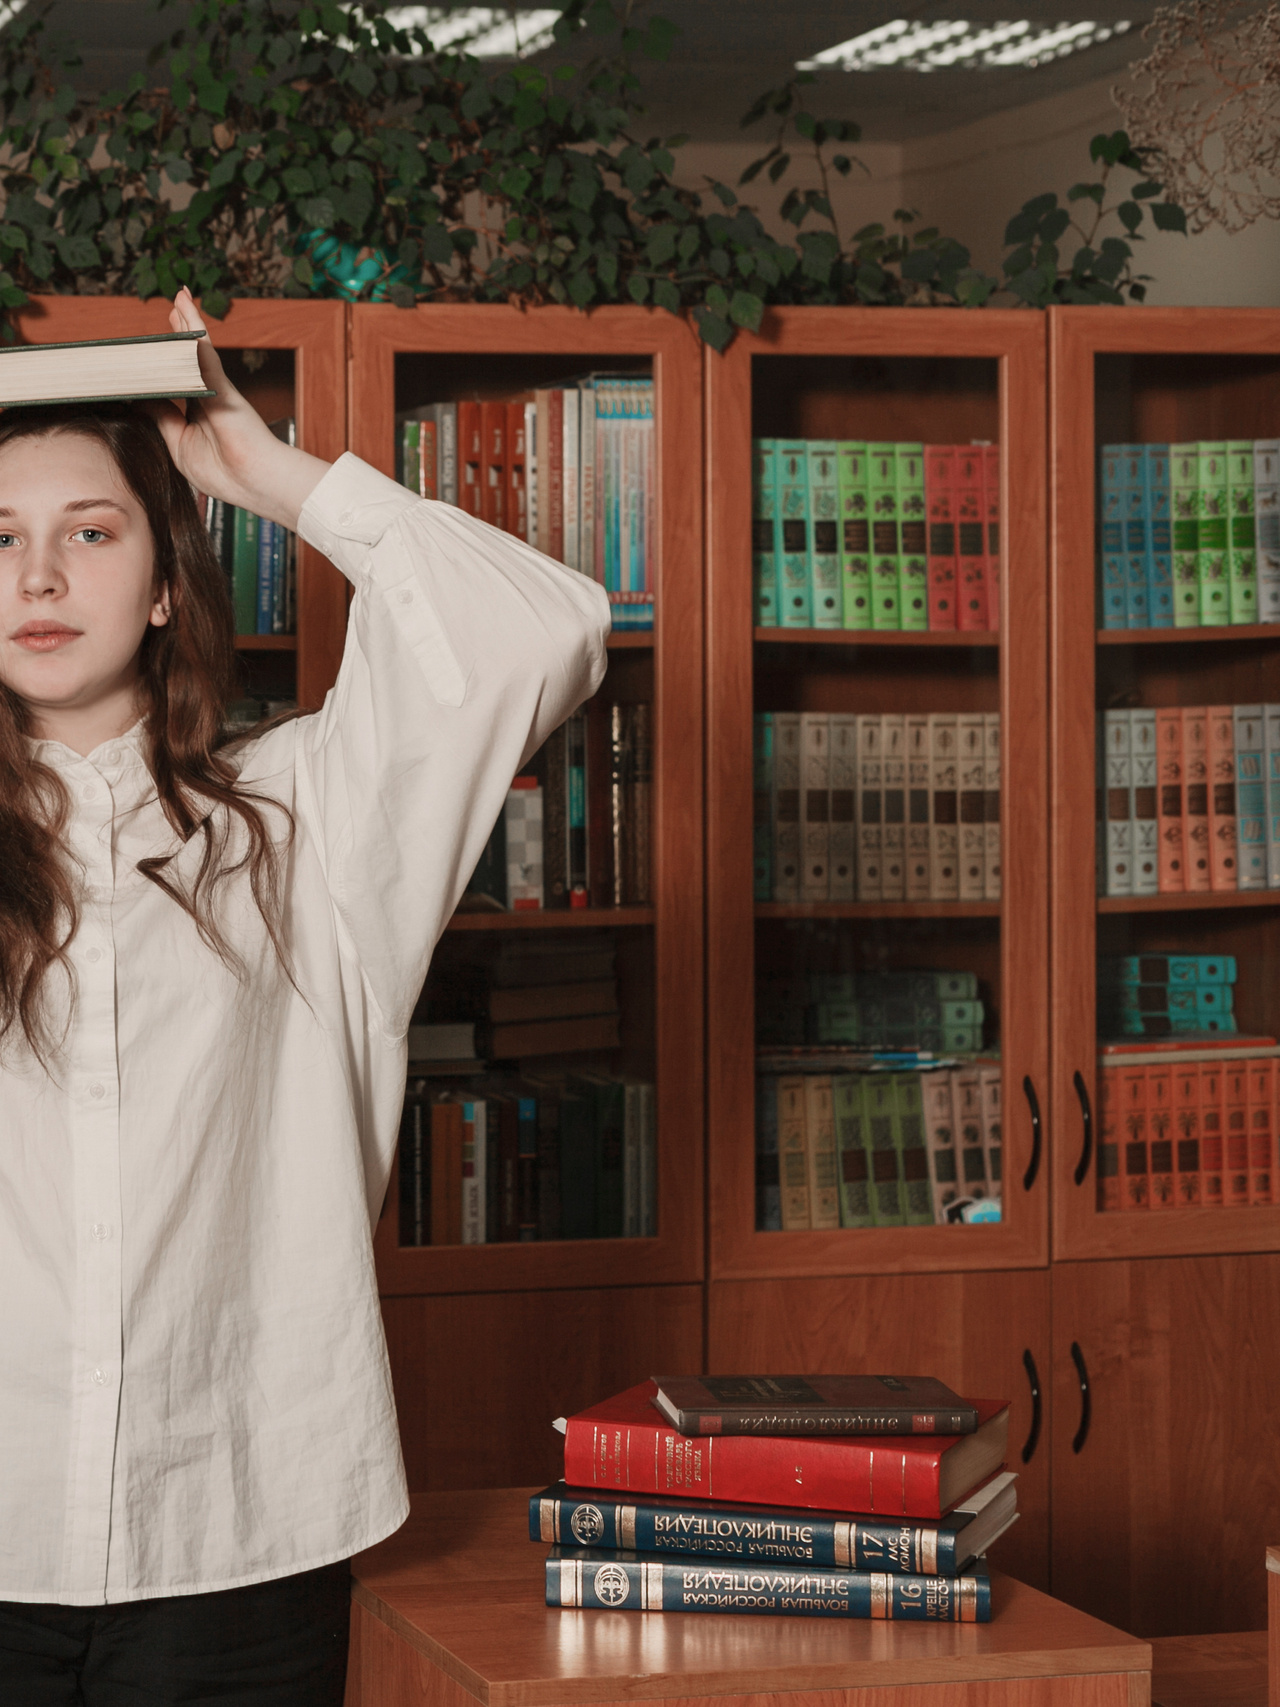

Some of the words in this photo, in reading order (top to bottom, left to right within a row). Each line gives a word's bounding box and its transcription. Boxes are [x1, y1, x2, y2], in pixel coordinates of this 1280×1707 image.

[739, 1415, 899, 1431] ЭНЦИКЛОПЕДИЯ
[665, 1435, 674, 1488] ТОЛКОВЫЙ
[675, 1443, 684, 1484] СЛОВАРЬ
[684, 1439, 693, 1488] РУССКОГО
[694, 1449, 702, 1481] ЯЗЫКА
[654, 1514, 813, 1543] ЭНЦИКЛОПЕДИЯ
[655, 1535, 743, 1553] РОССИЙСКАЯ
[748, 1542, 813, 1558] БОЛЬШАЯ
[862, 1531, 884, 1559] 17
[900, 1527, 910, 1572] ЛОМОН
[683, 1570, 849, 1595] ЭНЦИКЛОПЕДИЯ
[900, 1583, 922, 1610] 16
[683, 1592, 776, 1608] РОССИЙСКАЯ
[781, 1597, 849, 1611] БОЛЬШАЯ
[926, 1579, 938, 1616] КРЕЩЕ
